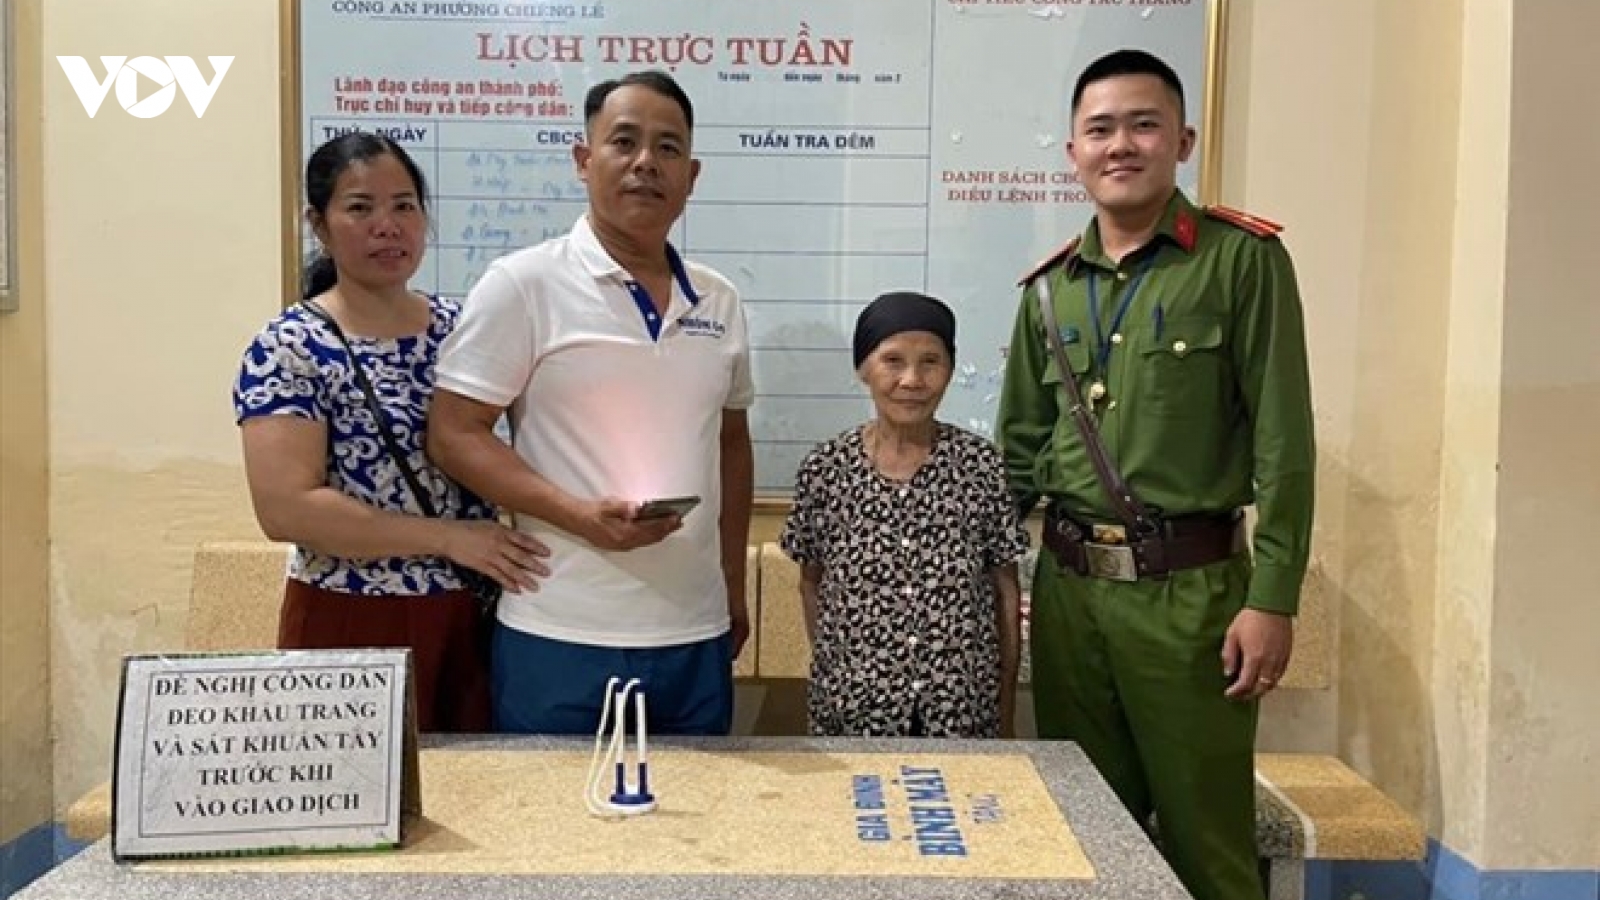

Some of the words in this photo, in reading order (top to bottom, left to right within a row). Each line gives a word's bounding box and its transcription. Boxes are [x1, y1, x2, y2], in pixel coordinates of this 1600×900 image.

[390, 1, 417, 14] AN
[477, 33, 584, 69] LỊCH
[598, 32, 714, 72] TRỰC
[726, 21, 854, 66] TUẦN
[455, 82, 475, 93] an
[404, 98, 432, 115] huy
[795, 134, 830, 149] TRA
[942, 170, 995, 184] DANH
[998, 166, 1046, 184] SÁCH
[193, 676, 257, 698] NGHỊ
[262, 669, 333, 692] CÔNG
[296, 701, 377, 720] TRANG
[152, 734, 184, 757] VÀ
[190, 733, 237, 756] SÁT
[197, 761, 283, 785] TRƯỚC
[290, 763, 333, 783] KHI
[174, 795, 227, 817] VÀO
[232, 796, 295, 816] GIAO
[300, 793, 360, 816] DỊCH
